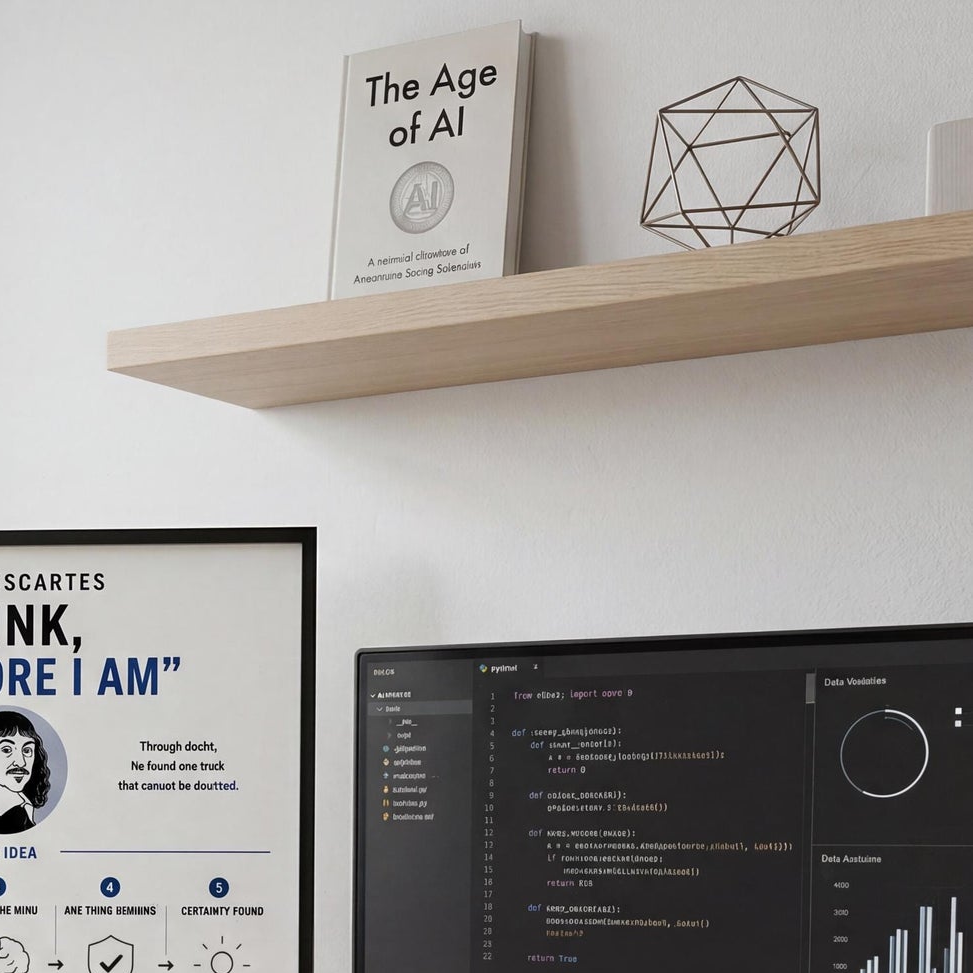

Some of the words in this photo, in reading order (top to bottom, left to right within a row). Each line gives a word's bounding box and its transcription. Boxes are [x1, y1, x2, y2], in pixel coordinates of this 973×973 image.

[366, 72, 420, 107] The
[429, 63, 497, 99] Age
[389, 111, 422, 147] of
[428, 106, 464, 141] AI
[73, 658, 82, 695] I
[97, 657, 181, 695] AM”
[139, 741, 182, 754] Through
[147, 761, 176, 770] found
[118, 780, 139, 790] that
[178, 781, 191, 790] be
[4, 847, 37, 859] IDEA
[106, 882, 114, 892] 4
[216, 883, 223, 893] 5
[85, 906, 113, 915] THING
[233, 907, 264, 916] FOUND
